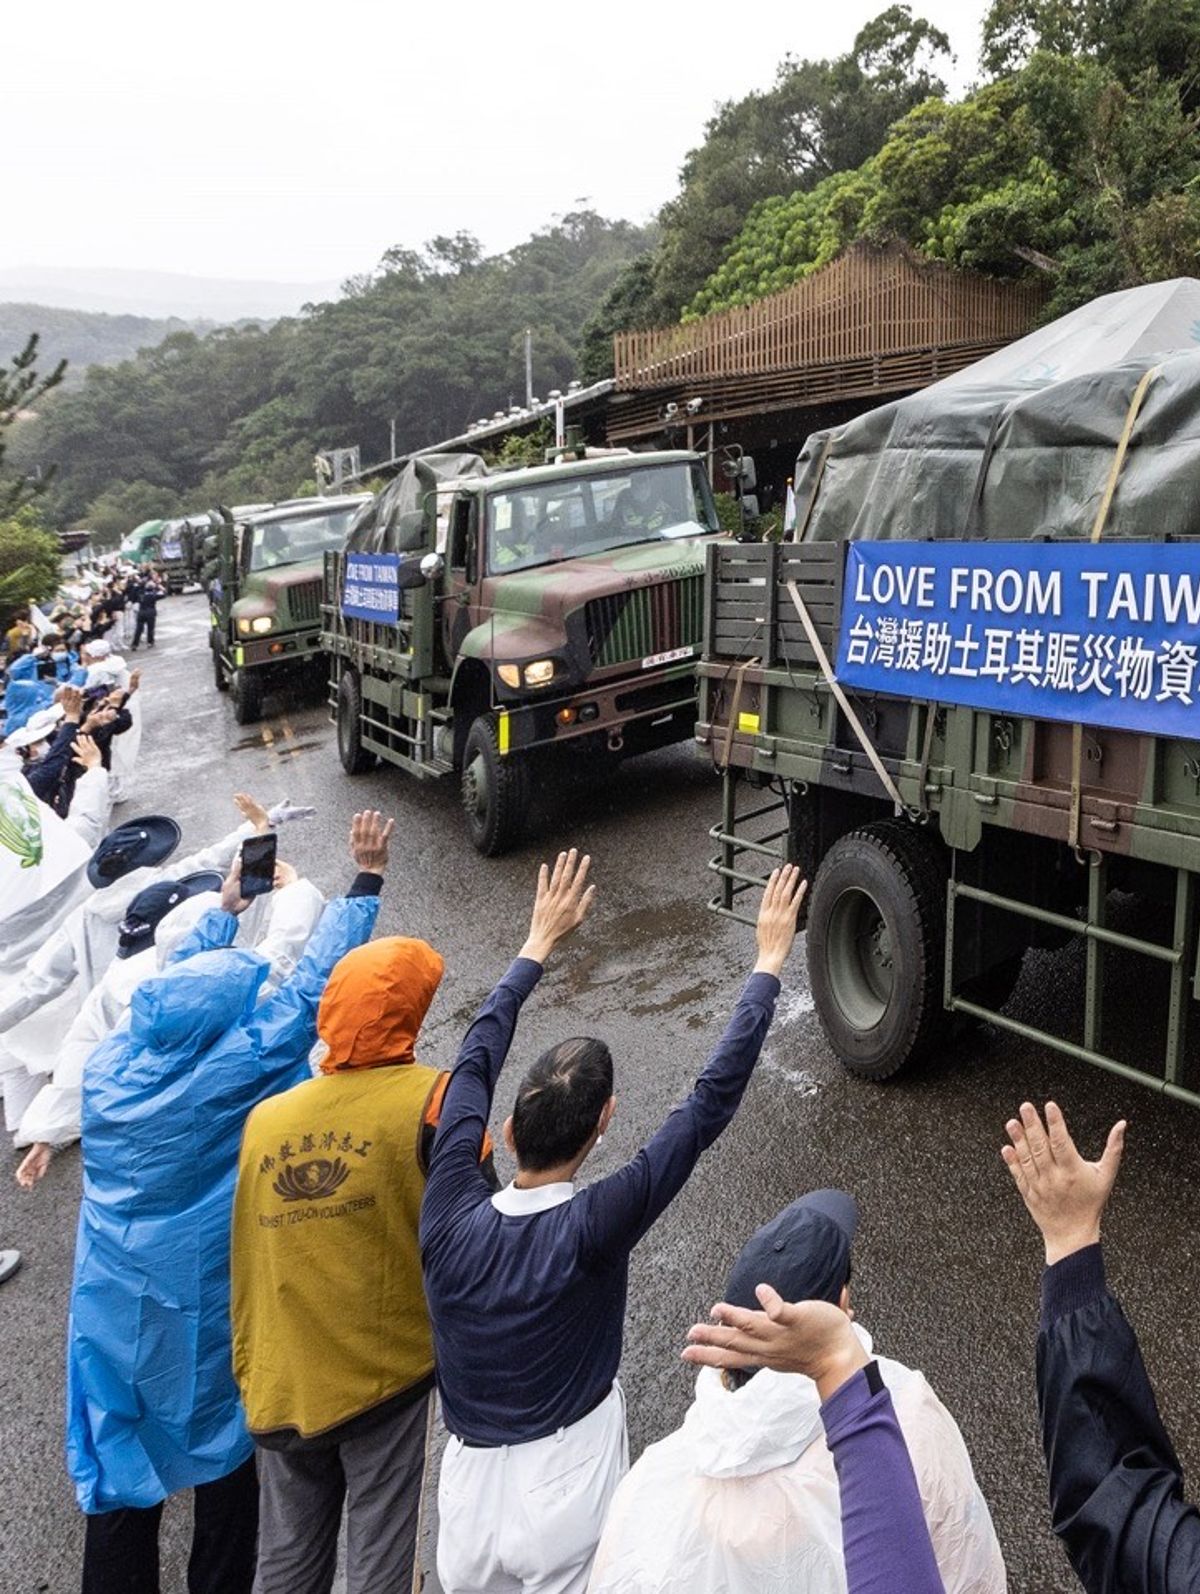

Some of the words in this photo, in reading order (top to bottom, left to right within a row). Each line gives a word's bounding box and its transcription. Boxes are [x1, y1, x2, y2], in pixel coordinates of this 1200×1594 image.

[855, 563, 936, 608] LOVE
[949, 568, 1062, 616] FROM
[259, 1130, 372, 1174] 佛教慈濟志工
[321, 1196, 376, 1219] VOLUNTEERS
